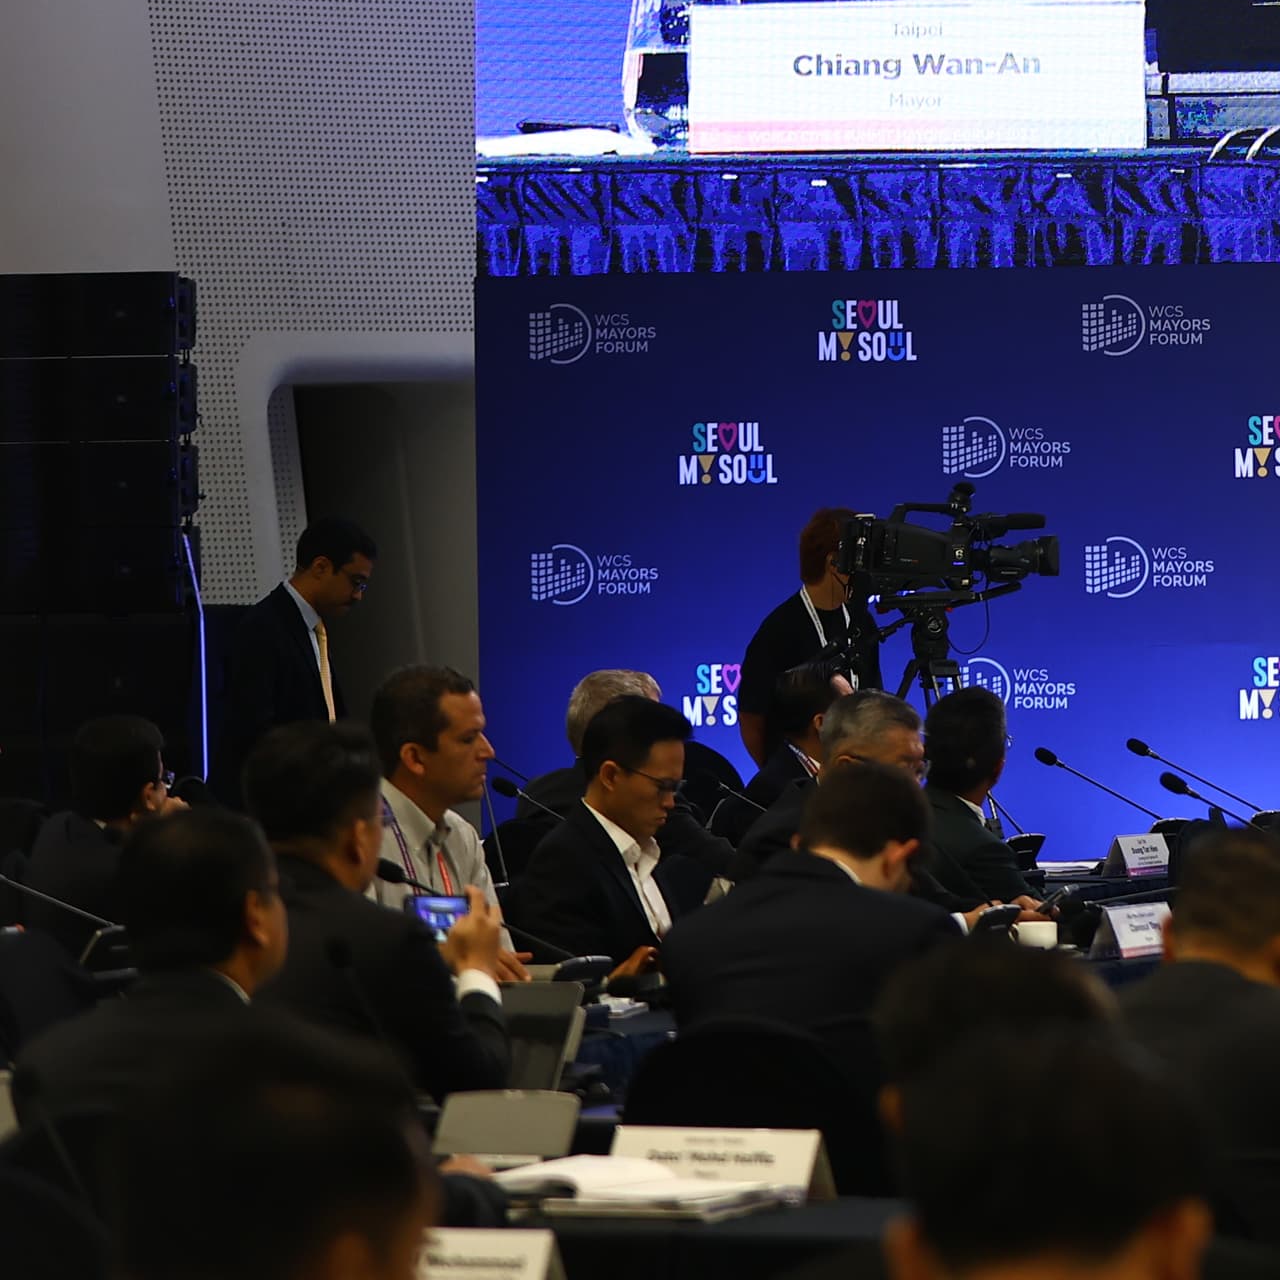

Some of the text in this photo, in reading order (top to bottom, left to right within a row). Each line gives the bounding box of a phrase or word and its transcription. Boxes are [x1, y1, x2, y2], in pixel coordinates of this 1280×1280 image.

[793, 51, 1042, 80] Chiang Wan-An
[889, 91, 942, 109] Mayor
[1149, 306, 1183, 317] WCS
[595, 314, 629, 325] WCS
[1150, 319, 1210, 331] MAYORS
[596, 327, 656, 339] MAYORS
[1150, 333, 1202, 345] FORUM
[596, 341, 648, 353] FORUM
[858, 332, 917, 361] SOUL
[1009, 428, 1043, 440] WCS
[1010, 442, 1070, 453] MAYORS
[1010, 456, 1062, 467] FORUM
[719, 454, 777, 484] SOUL
[1152, 547, 1186, 559] WCS
[597, 555, 631, 566] WCS
[1153, 561, 1214, 573] MAYORS
[598, 568, 658, 580] MAYORS
[1153, 575, 1206, 587] FORUM
[598, 582, 650, 594] FORUM
[1014, 669, 1048, 681] WCS
[1015, 683, 1075, 695] MAYORS
[1015, 697, 1067, 709] FORUM
